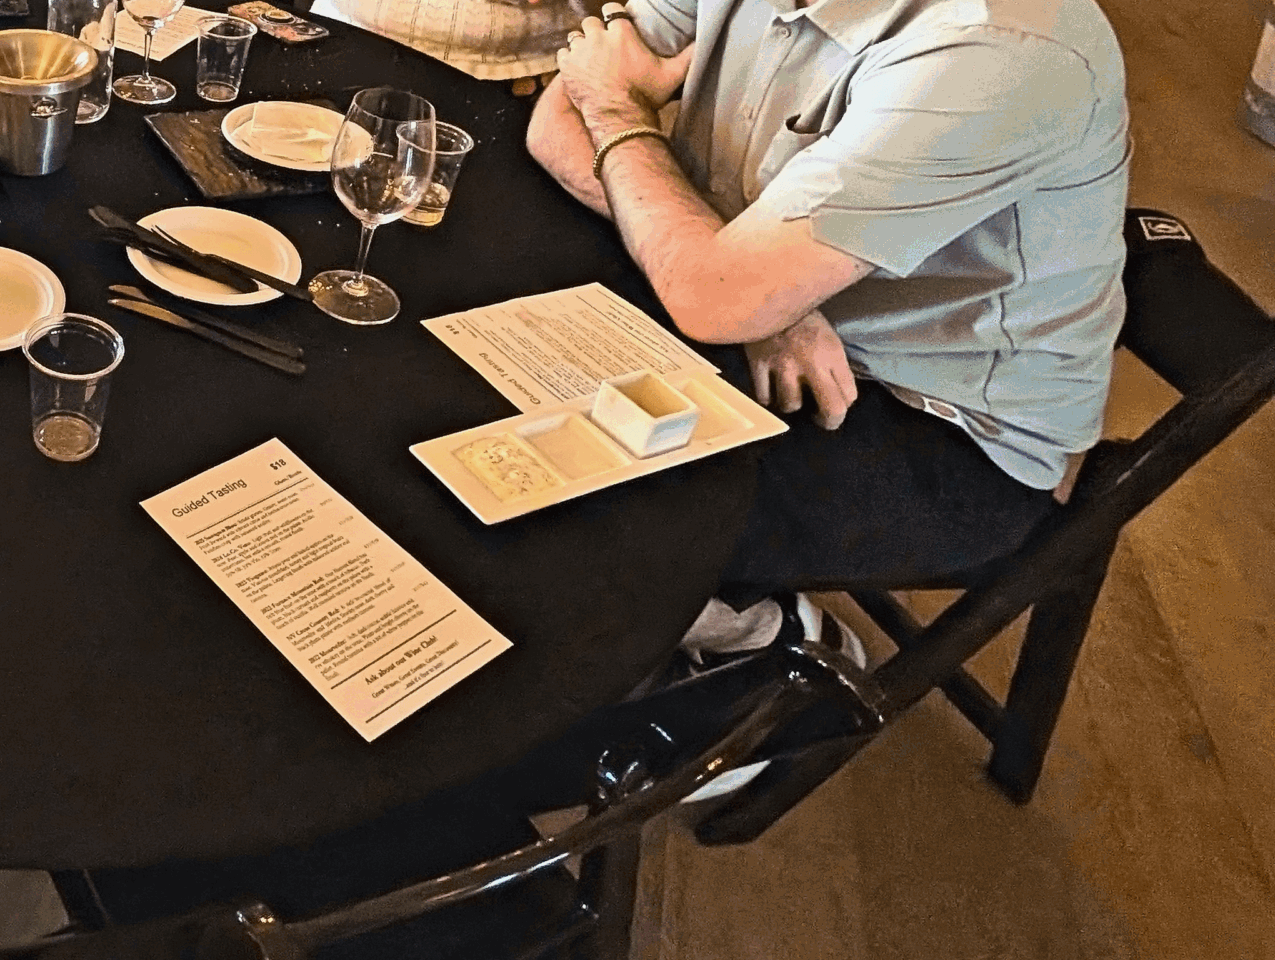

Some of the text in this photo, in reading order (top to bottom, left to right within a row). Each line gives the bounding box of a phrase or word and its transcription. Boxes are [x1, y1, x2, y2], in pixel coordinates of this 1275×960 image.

[269, 458, 286, 470] $18
[171, 478, 247, 517] Guided Tasting
[364, 634, 437, 685] Ask about our Wine Club!
